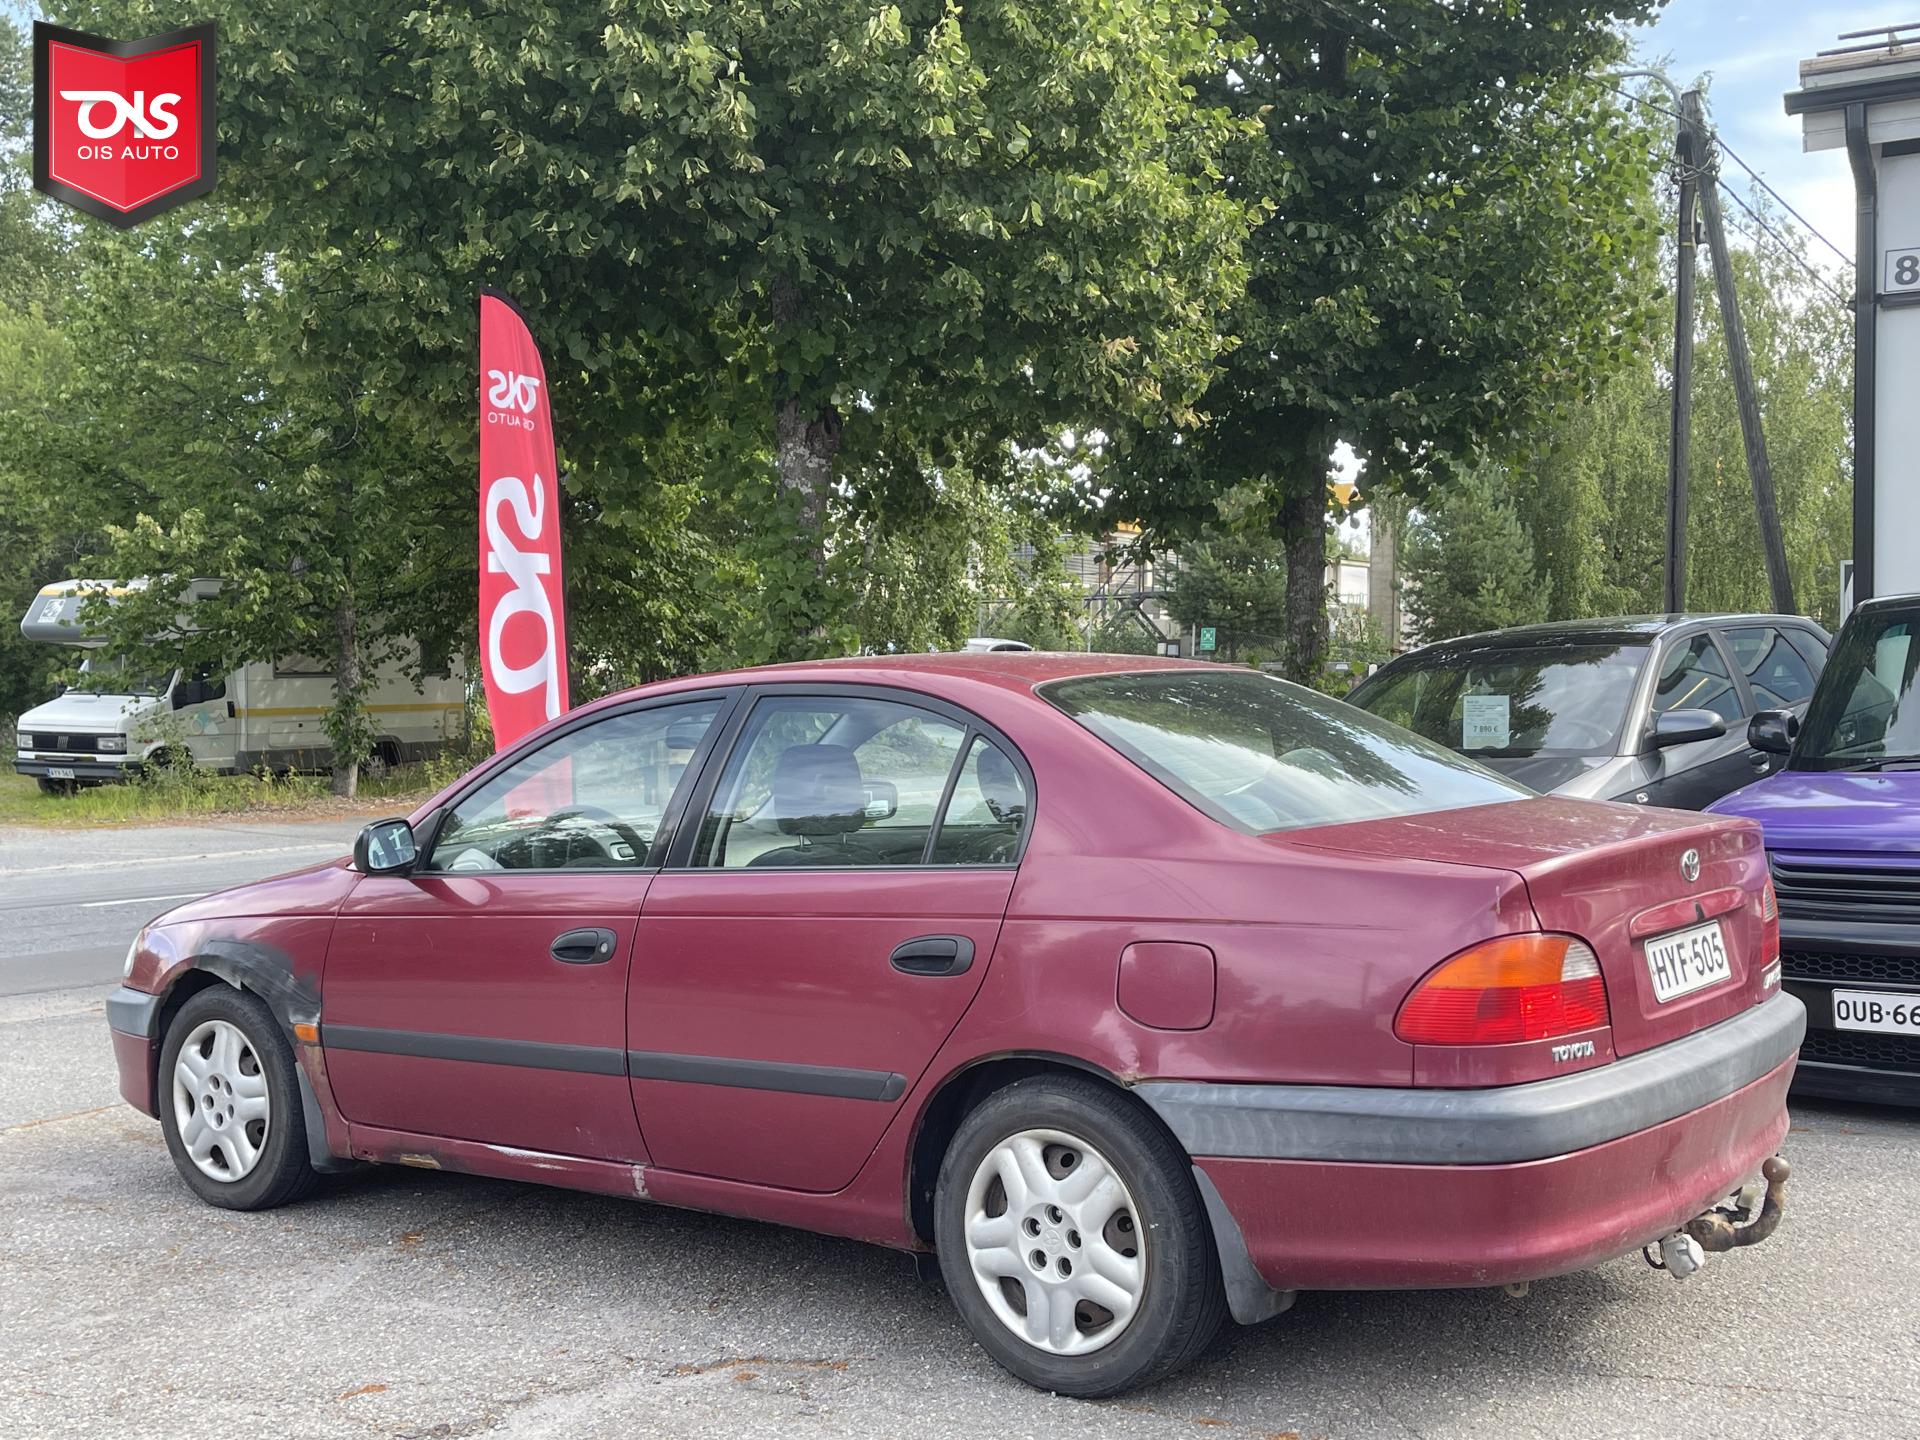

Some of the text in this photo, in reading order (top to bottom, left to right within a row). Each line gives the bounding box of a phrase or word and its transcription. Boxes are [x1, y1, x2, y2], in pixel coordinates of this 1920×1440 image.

[1894, 255, 1920, 286] 8
[1652, 931, 1725, 991] HYF-505
[1836, 999, 1920, 1027] OUB-66
[1552, 1040, 1596, 1063] TOYOTA
